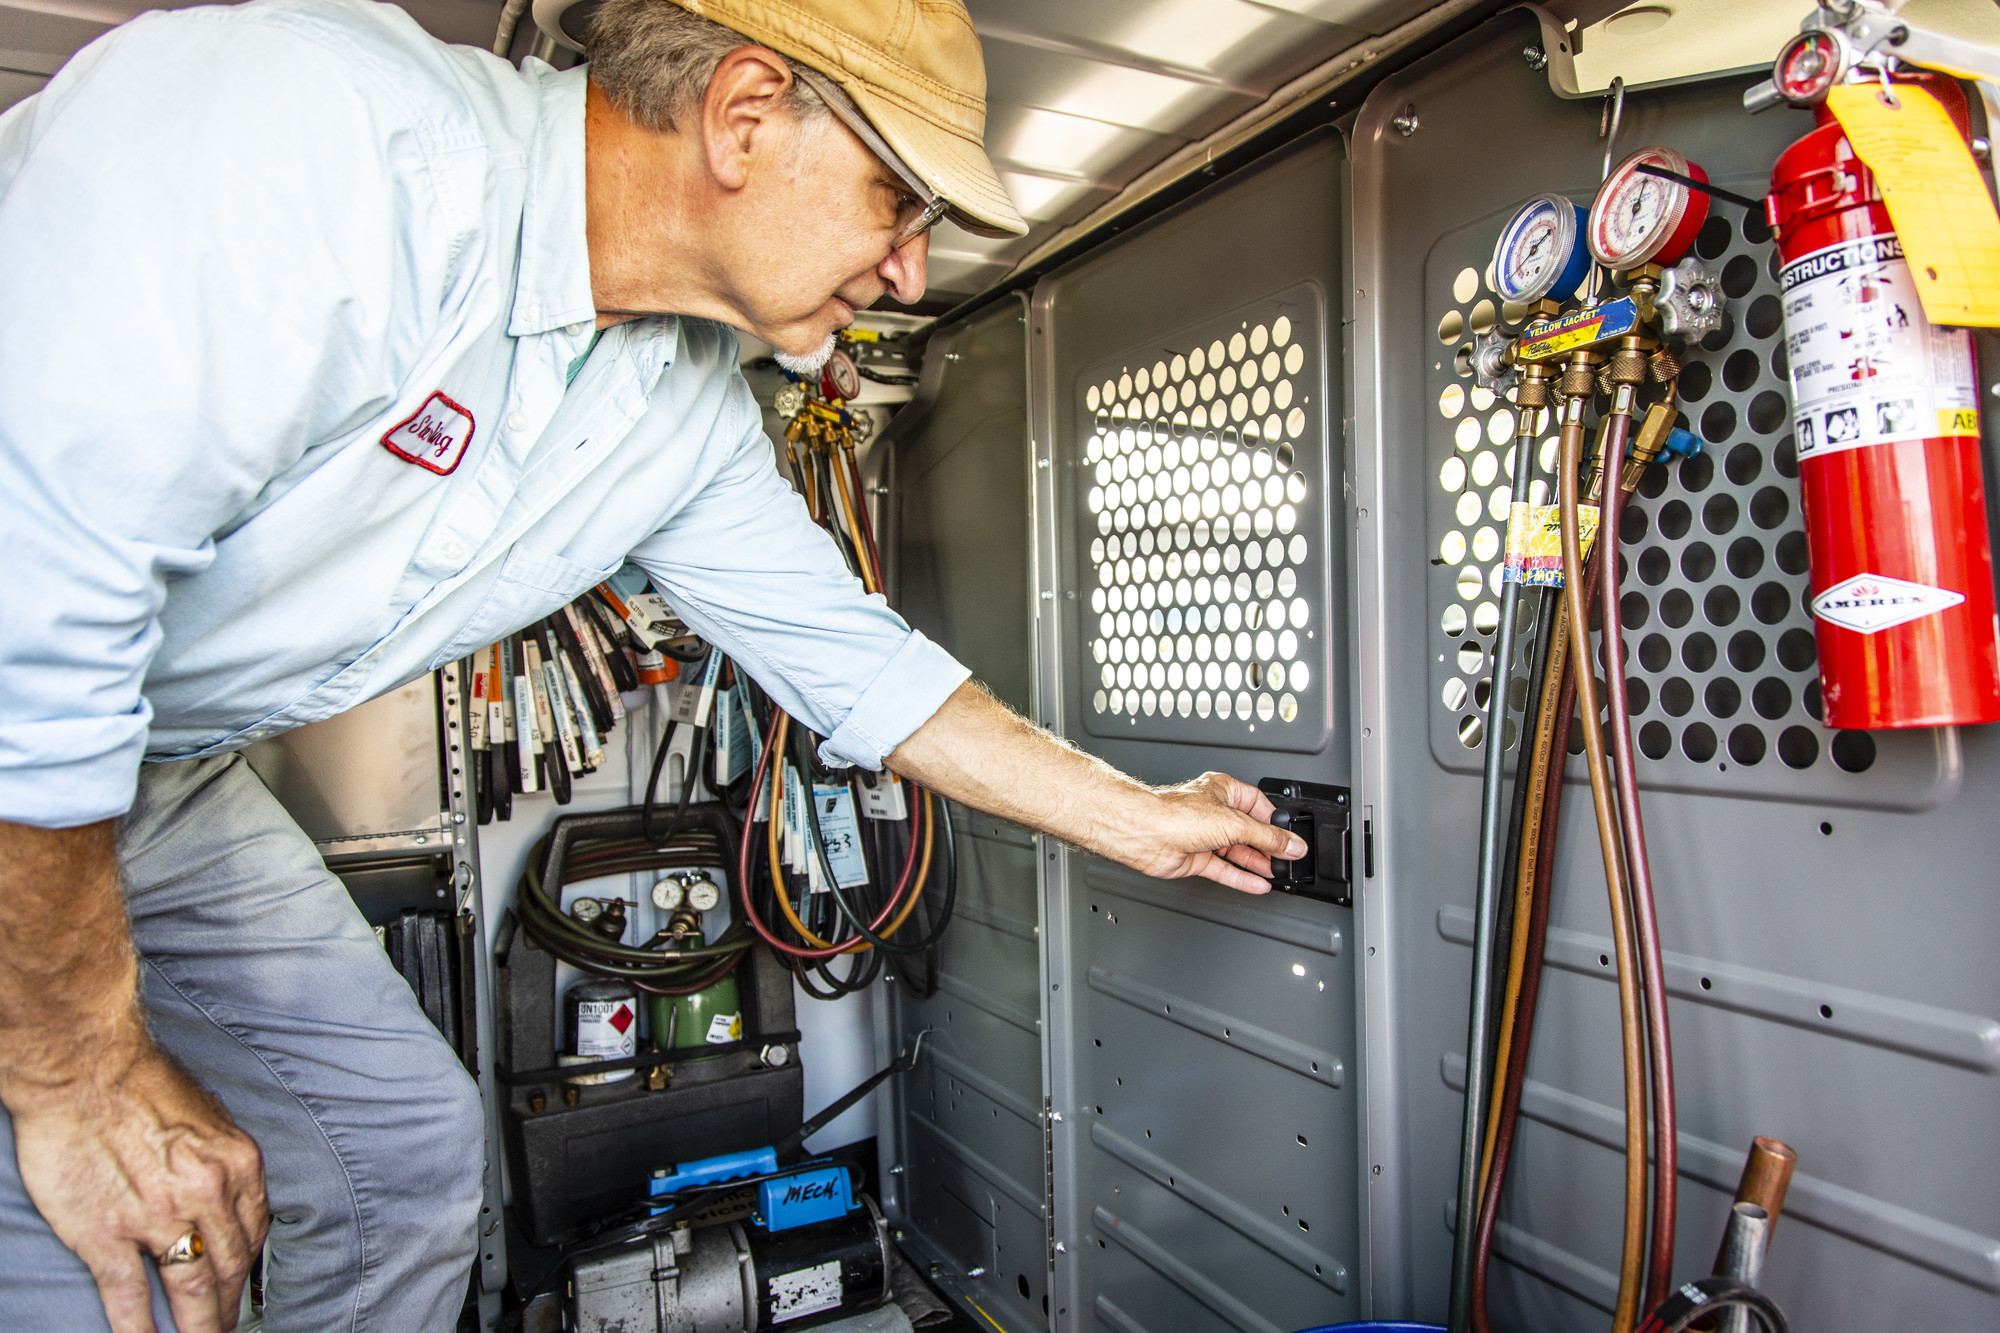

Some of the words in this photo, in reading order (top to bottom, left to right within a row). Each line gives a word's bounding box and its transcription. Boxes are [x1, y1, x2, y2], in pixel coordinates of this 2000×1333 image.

[1530, 321, 1561, 337] YELLOW
[1563, 309, 1598, 327] JACKET
[538, 695, 547, 716] v-belt
[1546, 683, 1557, 712] Charging
[1544, 714, 1553, 730] Hose
[581, 1003, 614, 1014] UN1001
[782, 1177, 839, 1206] MECH.
